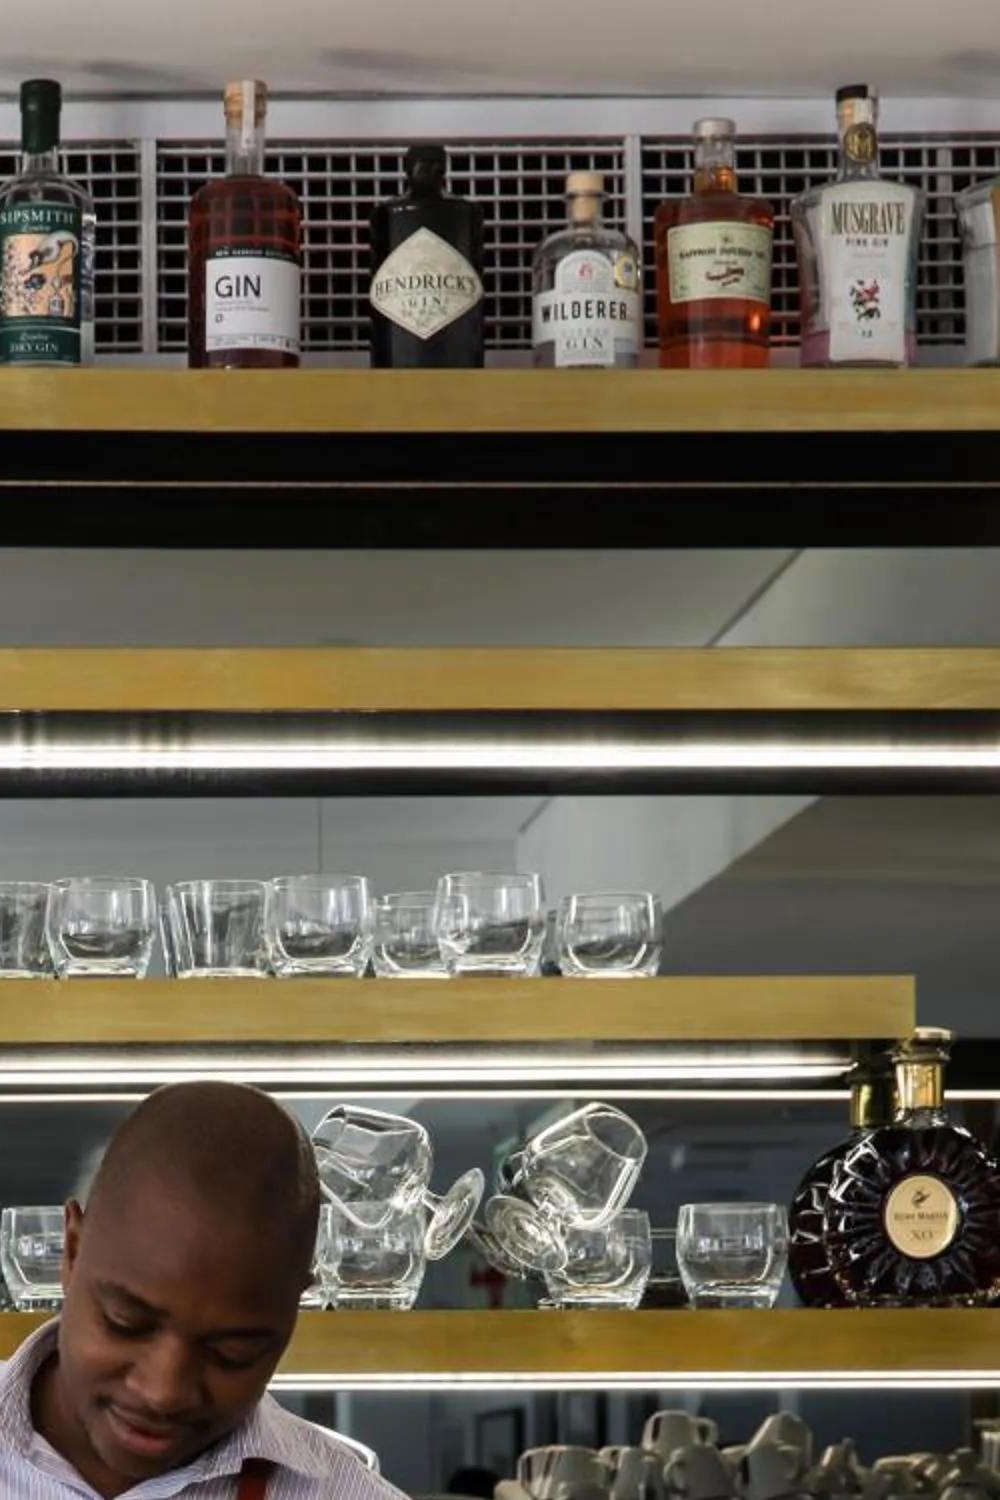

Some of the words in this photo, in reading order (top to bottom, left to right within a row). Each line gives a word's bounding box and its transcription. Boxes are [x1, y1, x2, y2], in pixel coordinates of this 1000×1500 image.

[0, 209, 74, 226] SIPSMITH
[831, 201, 905, 235] MUSGRAVE
[215, 275, 261, 298] GIN
[375, 273, 477, 300] HENDRICK'S
[541, 300, 627, 323] WILDERER
[35, 342, 59, 354] GIN
